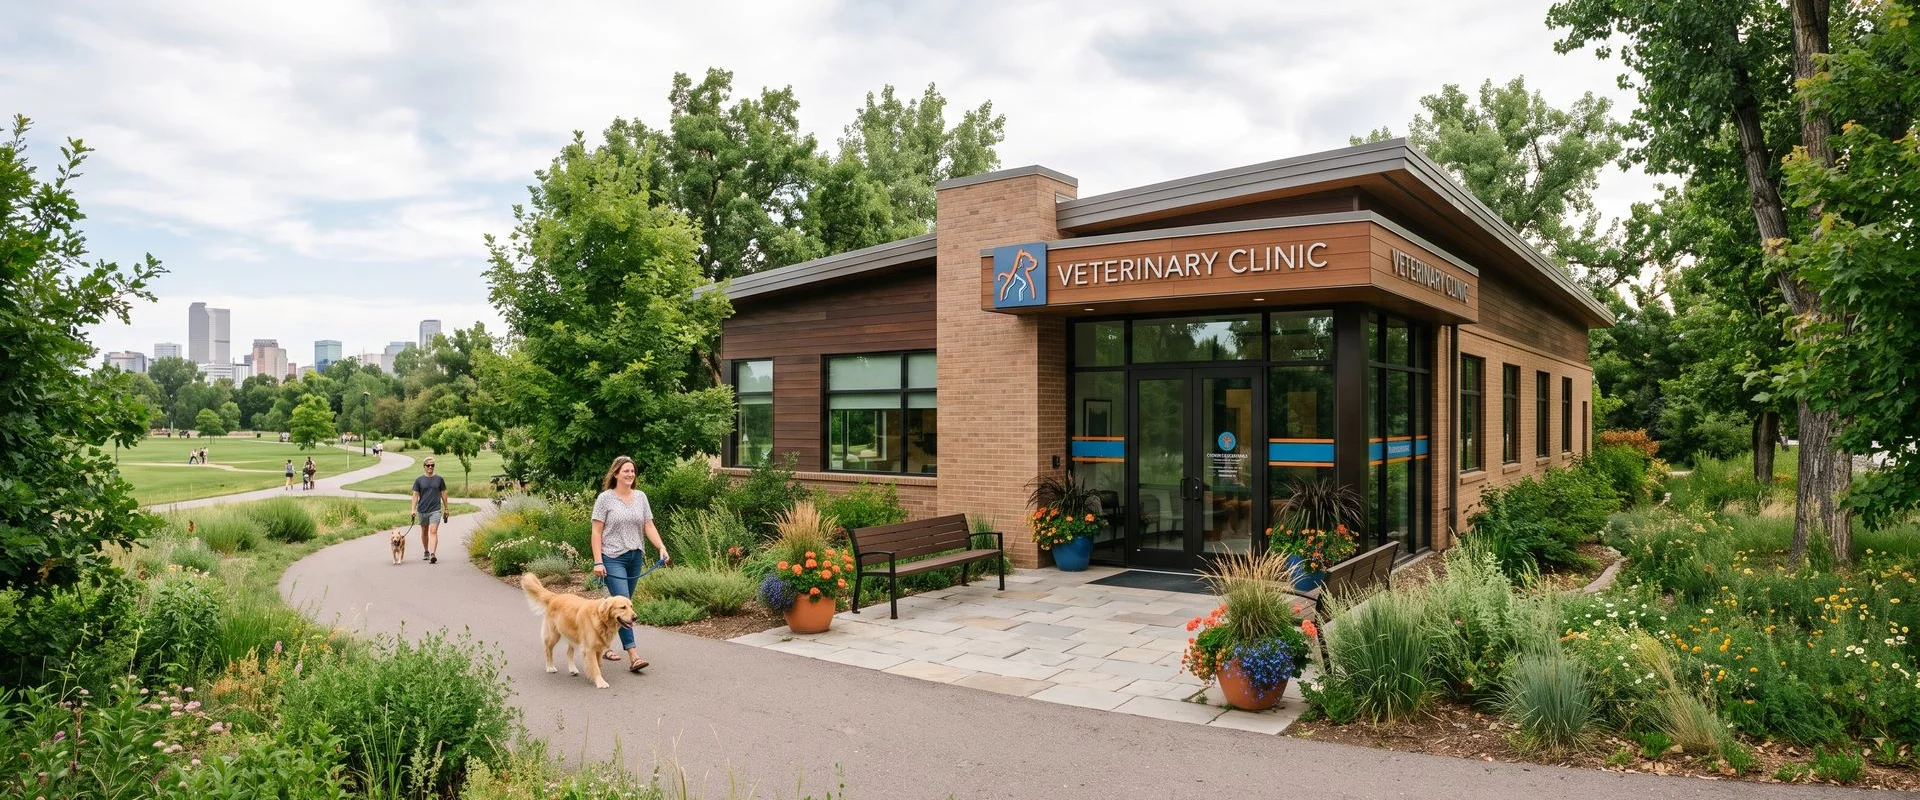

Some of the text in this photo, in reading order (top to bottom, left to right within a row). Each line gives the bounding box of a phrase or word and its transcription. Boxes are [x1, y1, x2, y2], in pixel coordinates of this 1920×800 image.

[1057, 242, 1328, 286] VETERINARY CLINIC
[1391, 248, 1469, 303] VETERINARY CLINIC
